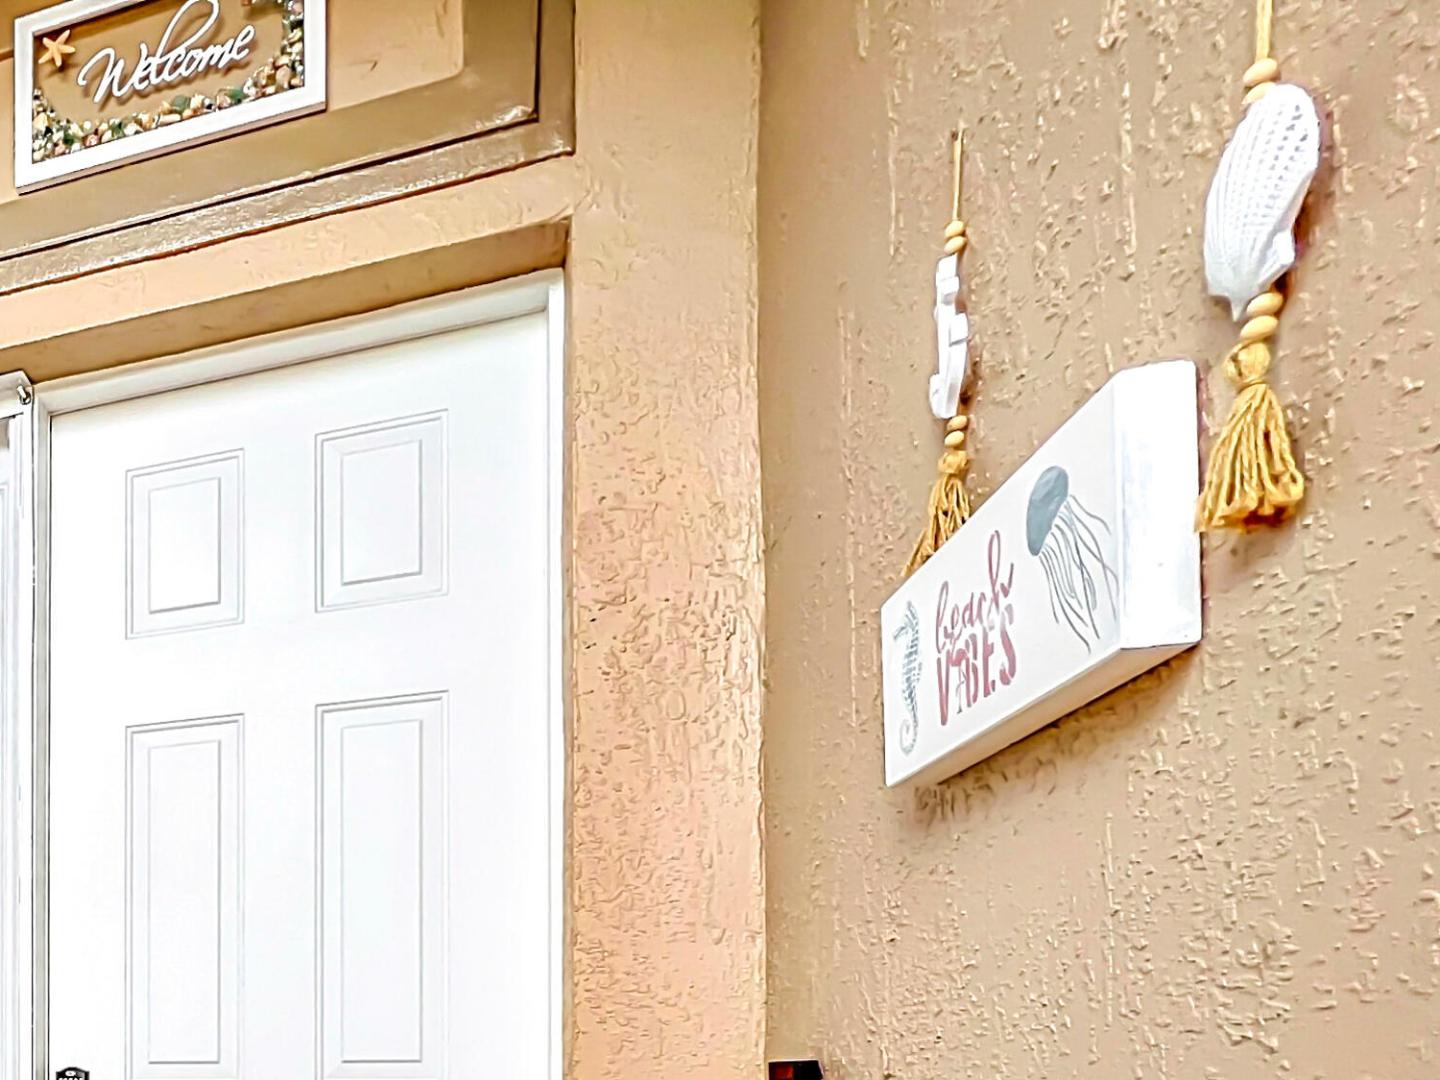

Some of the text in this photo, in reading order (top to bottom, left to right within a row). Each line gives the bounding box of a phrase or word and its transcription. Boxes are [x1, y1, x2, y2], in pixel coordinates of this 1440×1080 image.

[77, 0, 256, 104] Welcome
[935, 530, 1014, 656] beach
[936, 603, 1017, 726] VIBES
